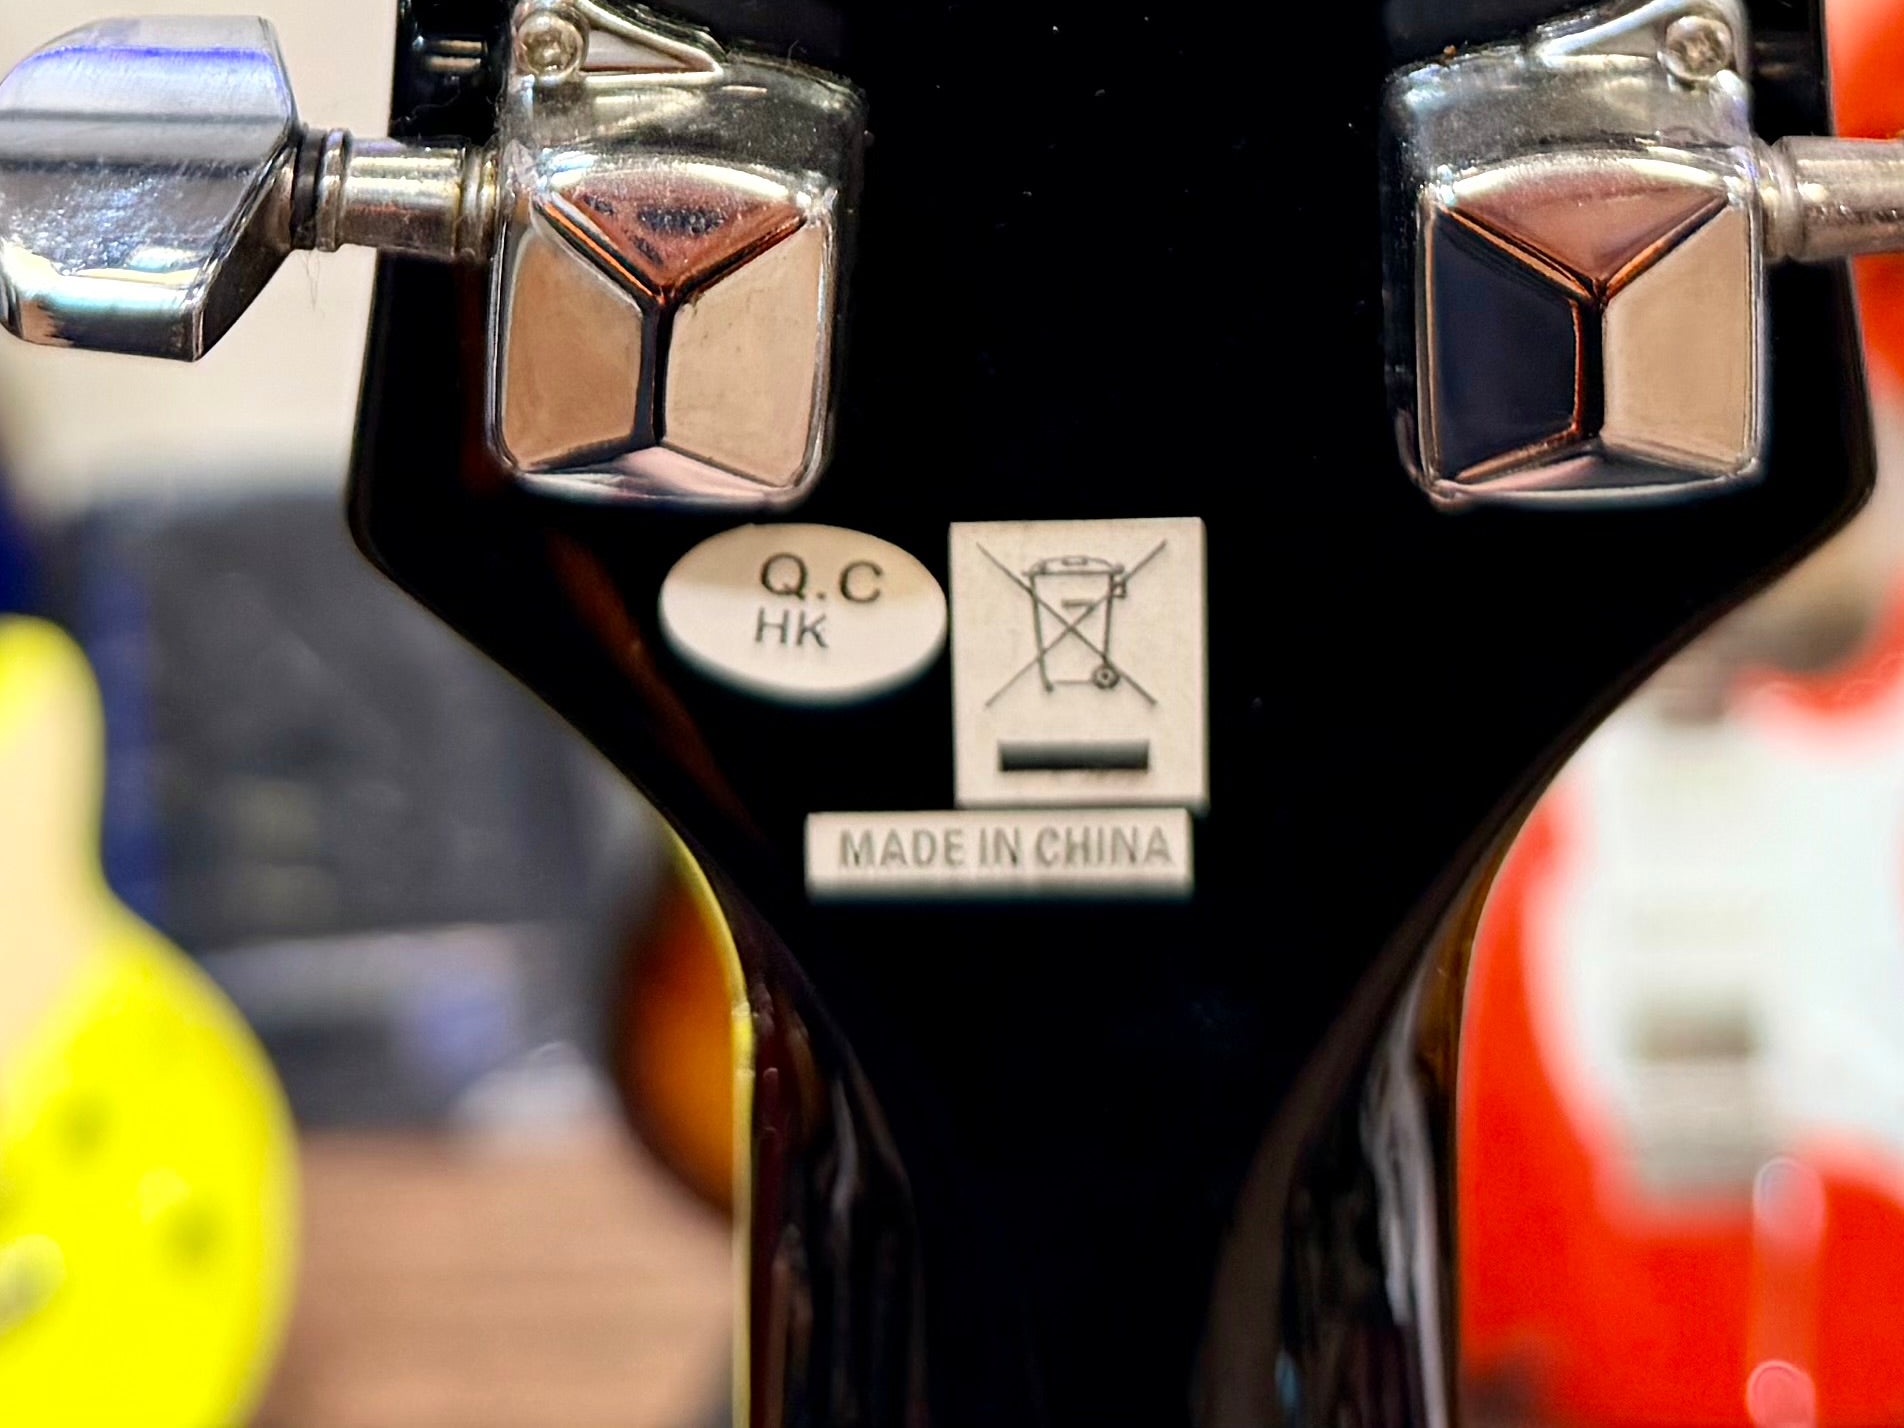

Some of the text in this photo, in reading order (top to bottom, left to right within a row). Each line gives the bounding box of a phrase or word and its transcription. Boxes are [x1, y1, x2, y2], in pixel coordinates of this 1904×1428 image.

[760, 552, 884, 604] Q.C
[754, 606, 831, 649] HK
[838, 825, 1174, 868] MADE IN CHINA
